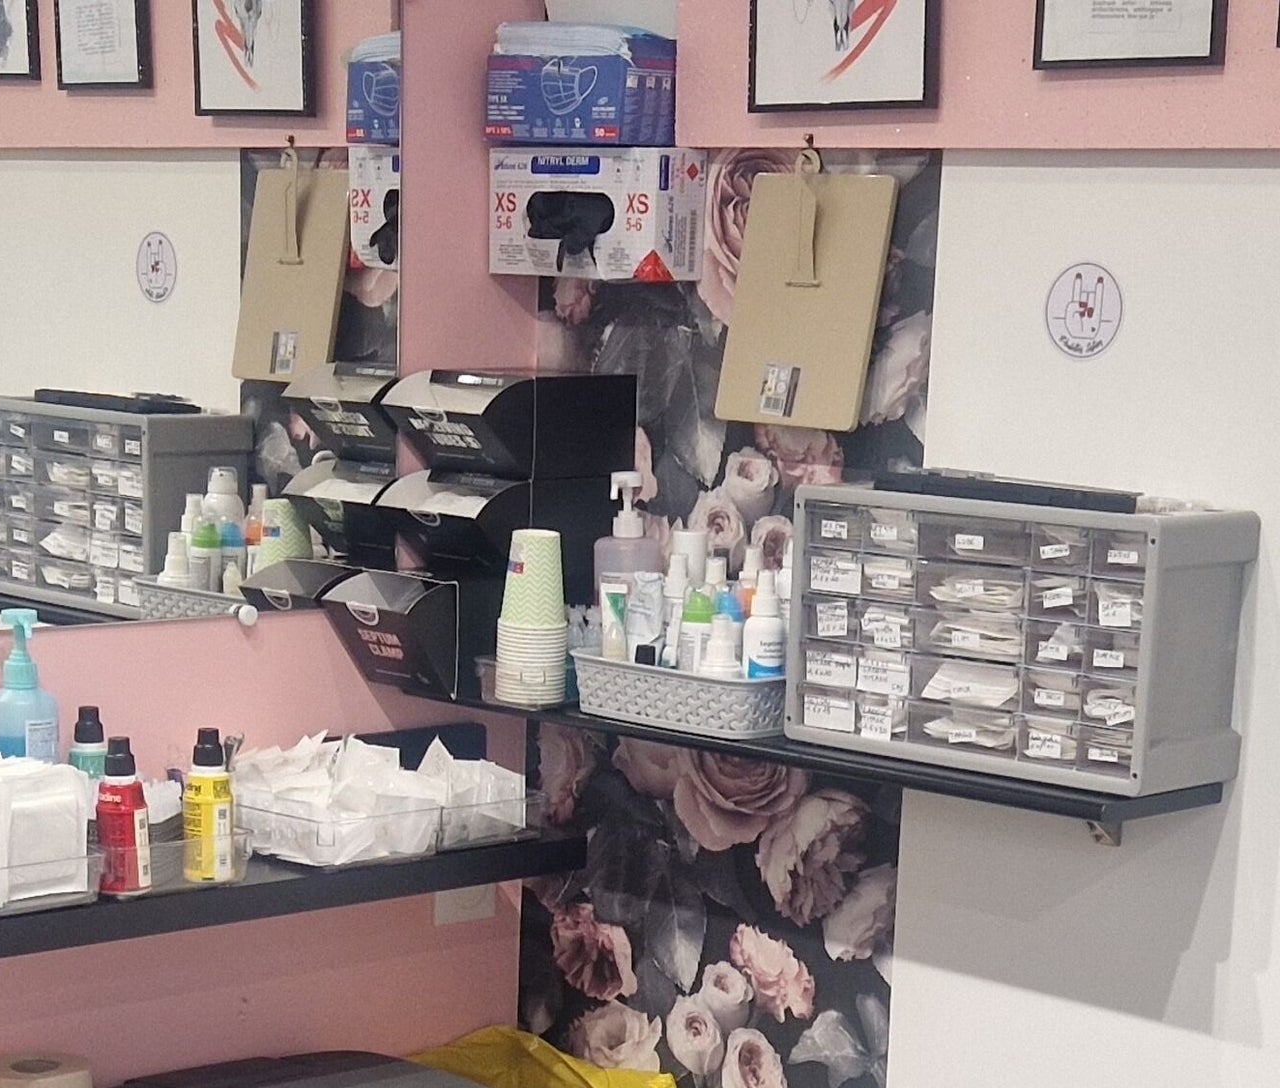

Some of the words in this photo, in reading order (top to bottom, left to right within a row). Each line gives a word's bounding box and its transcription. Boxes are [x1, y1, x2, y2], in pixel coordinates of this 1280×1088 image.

[495, 192, 517, 213] XS
[626, 193, 650, 214] XS
[495, 215, 513, 230] 5-6
[625, 217, 643, 232] 5-6
[357, 629, 402, 648] SEPTUM
[368, 643, 405, 661] CLAMP
